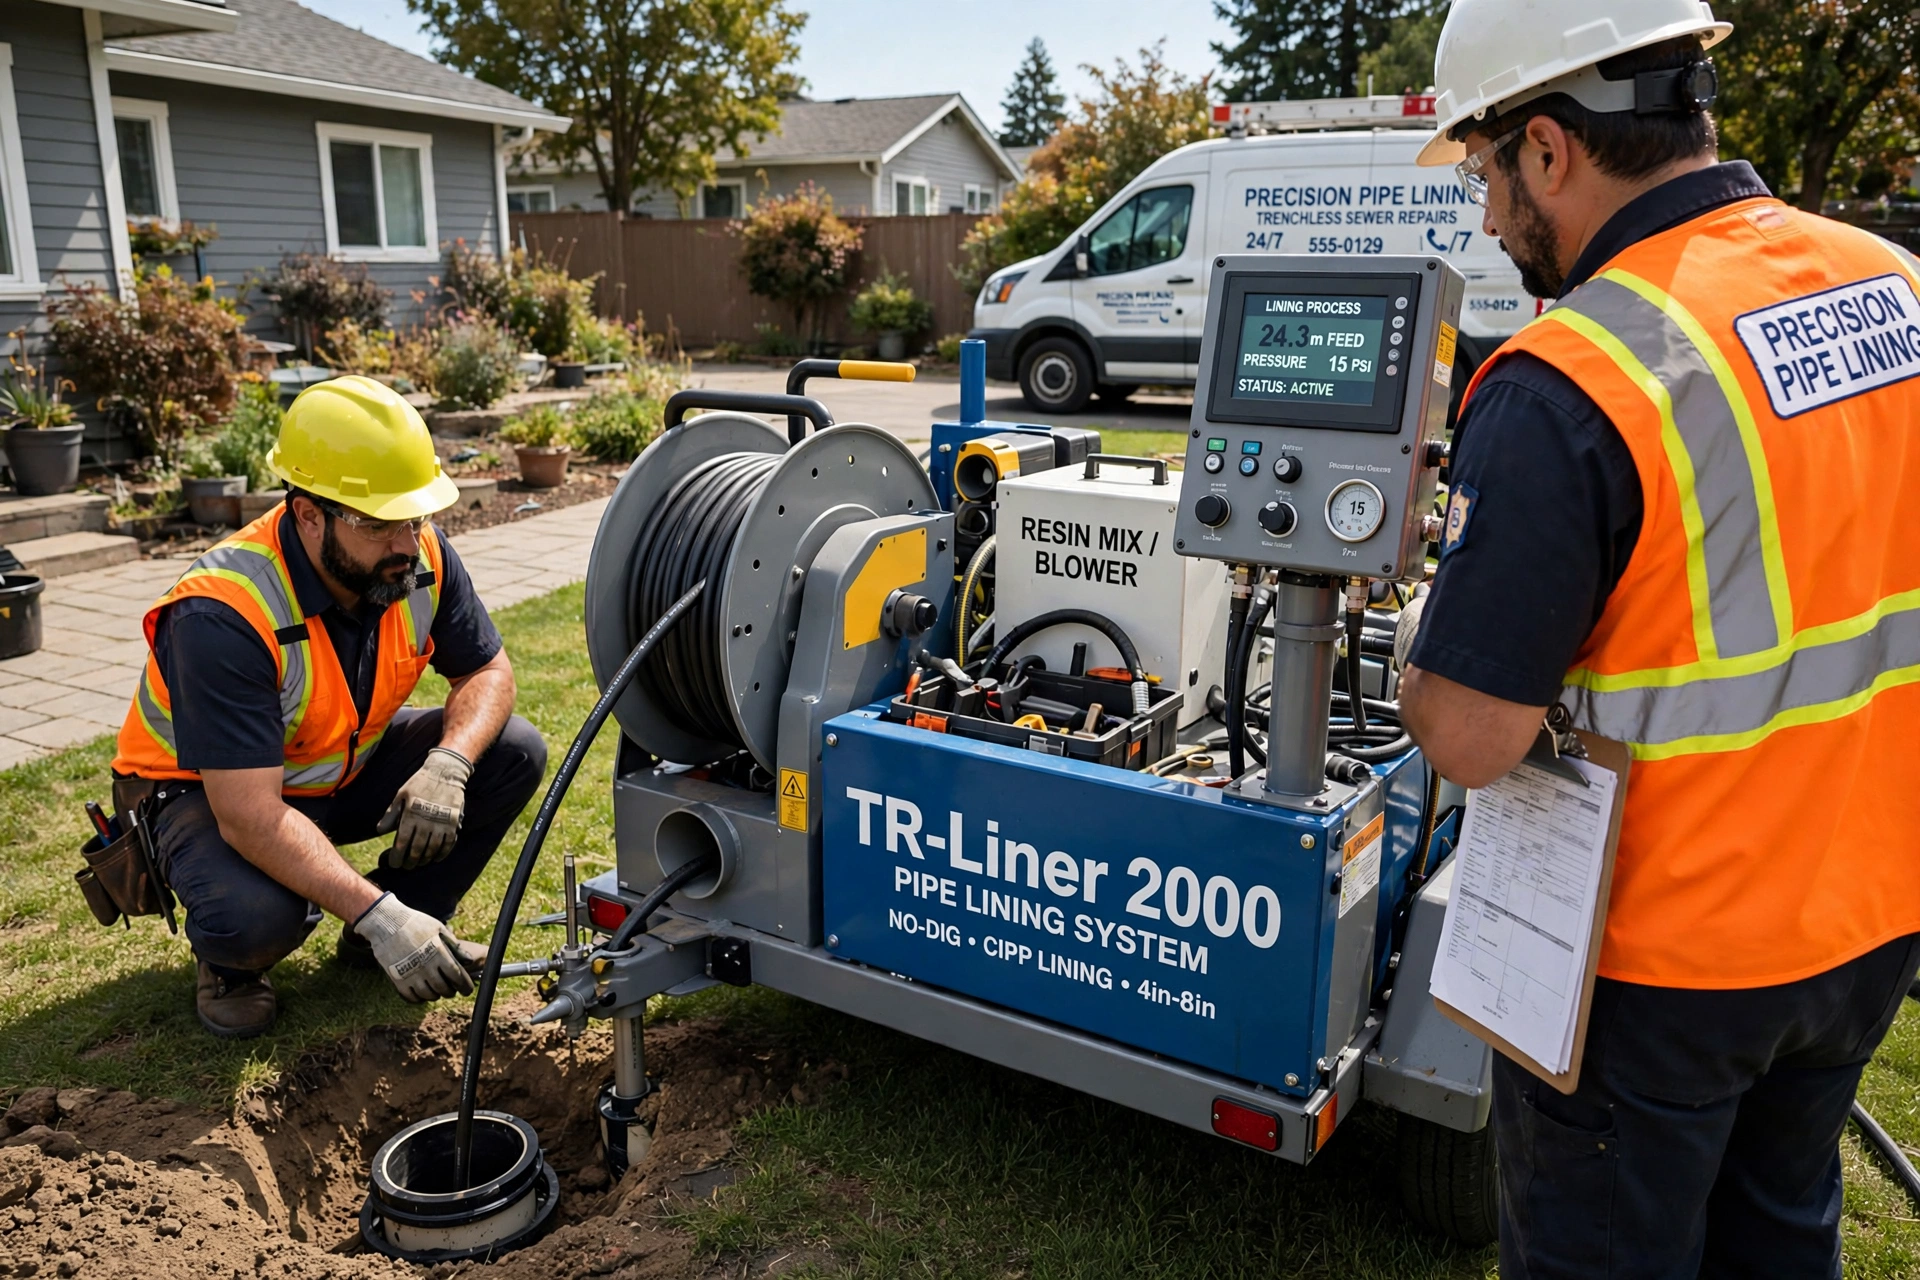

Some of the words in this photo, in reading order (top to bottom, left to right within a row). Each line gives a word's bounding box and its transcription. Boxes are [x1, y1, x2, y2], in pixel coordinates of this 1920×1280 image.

[1245, 186, 1351, 207] PRECISION
[1359, 186, 1405, 206] PIPE
[1257, 211, 1342, 225] TRENCHLESS
[1345, 211, 1394, 224] SEWER
[1399, 210, 1457, 224] REPAIRS
[1246, 232, 1283, 250] 24/7
[1308, 237, 1383, 254] 555-0129
[1265, 300, 1303, 313] LINING
[1306, 301, 1361, 315] PROCESS
[1759, 287, 1906, 357] PRECISION
[1326, 332, 1364, 348] FEED
[1243, 353, 1307, 369] PRESSURE
[1329, 355, 1348, 372] 15
[1351, 359, 1372, 373] PSI
[1774, 351, 1842, 401] PIPE
[1838, 325, 1920, 381] LINING
[1238, 379, 1287, 394] STATUS:
[1290, 381, 1334, 396] ACTIVE
[1350, 500, 1365, 515] 15
[1022, 516, 1090, 548] RESIN
[1099, 526, 1143, 555] MIX
[1035, 550, 1138, 587] BLOWER
[845, 786, 1108, 903] TR-Liner
[1125, 857, 1282, 949] 2000
[895, 865, 957, 907] PIPE
[966, 885, 1064, 936] LINING
[1074, 913, 1209, 975] SYSTEM
[889, 908, 961, 947] NO-DIG
[983, 934, 1032, 965] CIPP
[1038, 949, 1112, 990] LINING
[1137, 979, 1216, 1020] 4in-8in
